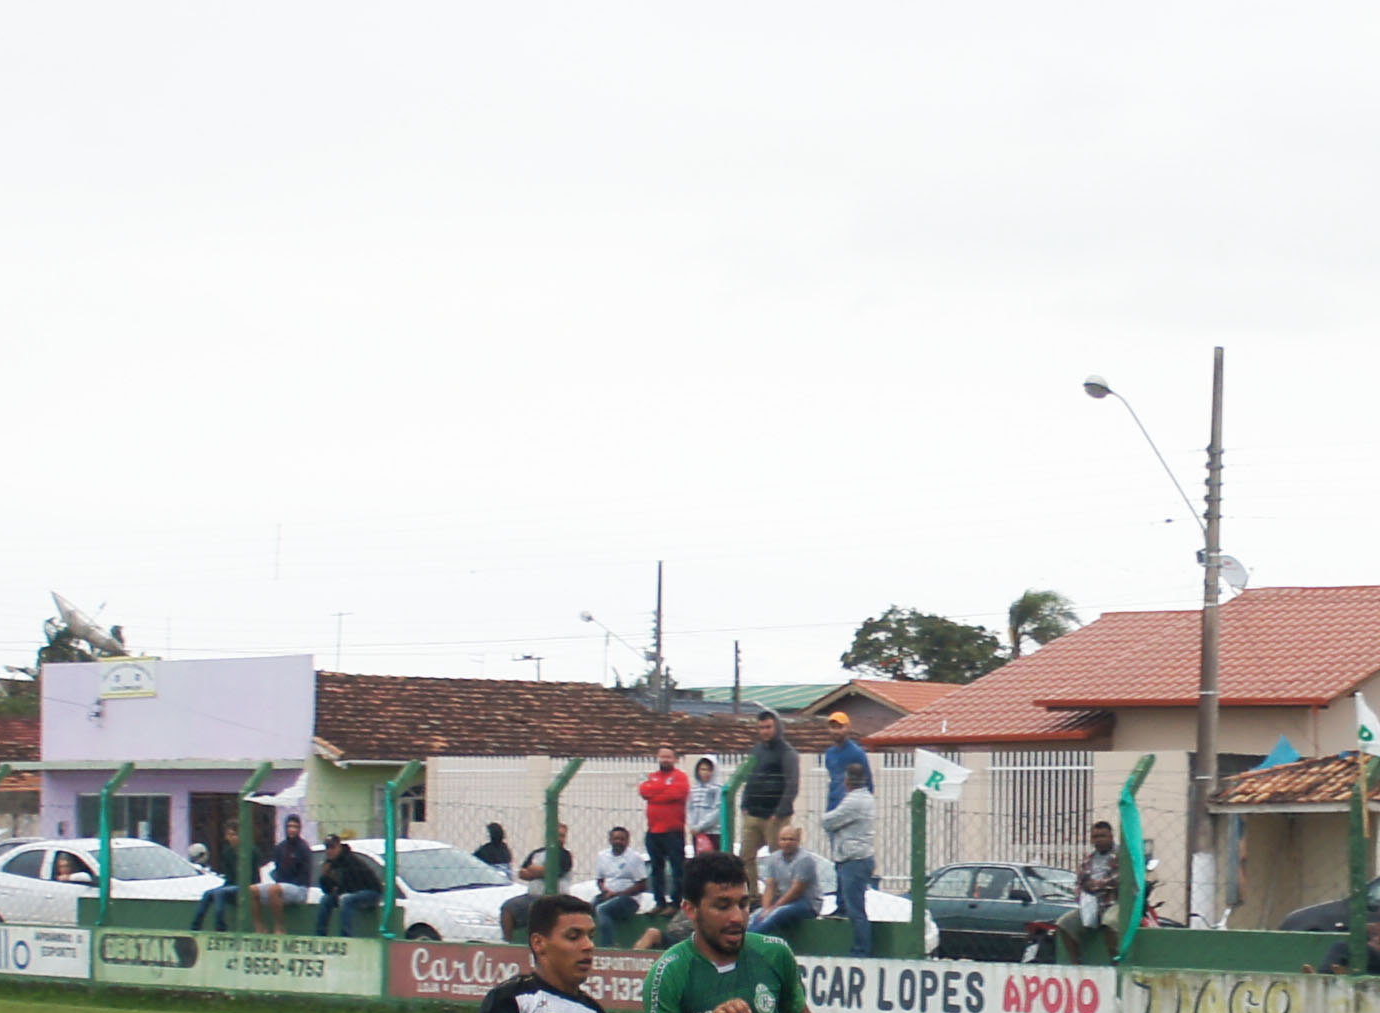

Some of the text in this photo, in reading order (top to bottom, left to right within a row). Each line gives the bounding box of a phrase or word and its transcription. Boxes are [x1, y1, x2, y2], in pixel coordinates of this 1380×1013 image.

[243, 956, 325, 978] 9650-4753
[797, 965, 866, 1009] SCAR
[877, 967, 986, 1013] LOPES
